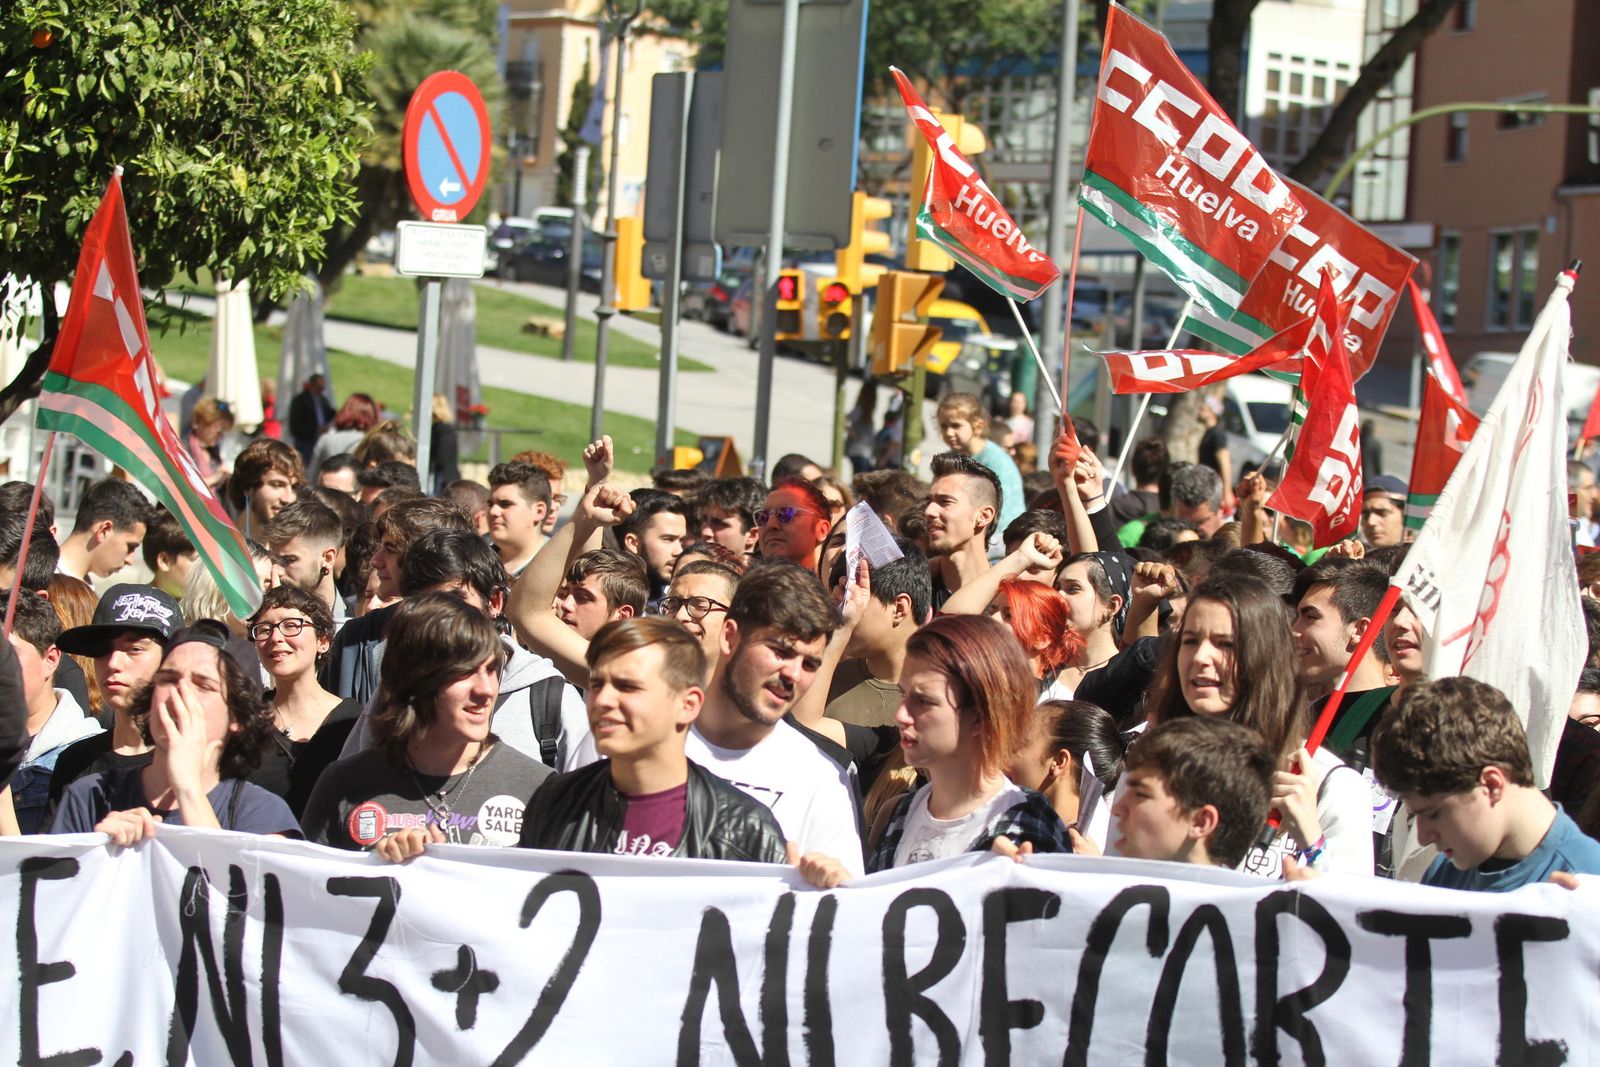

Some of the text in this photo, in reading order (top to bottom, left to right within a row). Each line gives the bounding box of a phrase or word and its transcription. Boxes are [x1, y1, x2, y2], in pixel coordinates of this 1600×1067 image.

[1097, 48, 1291, 215] CCOO
[1155, 154, 1260, 242] Huelva
[485, 805, 524, 820] YARD
[485, 819, 522, 834] SALE
[165, 864, 284, 1067] NI
[676, 891, 838, 1067] NI
